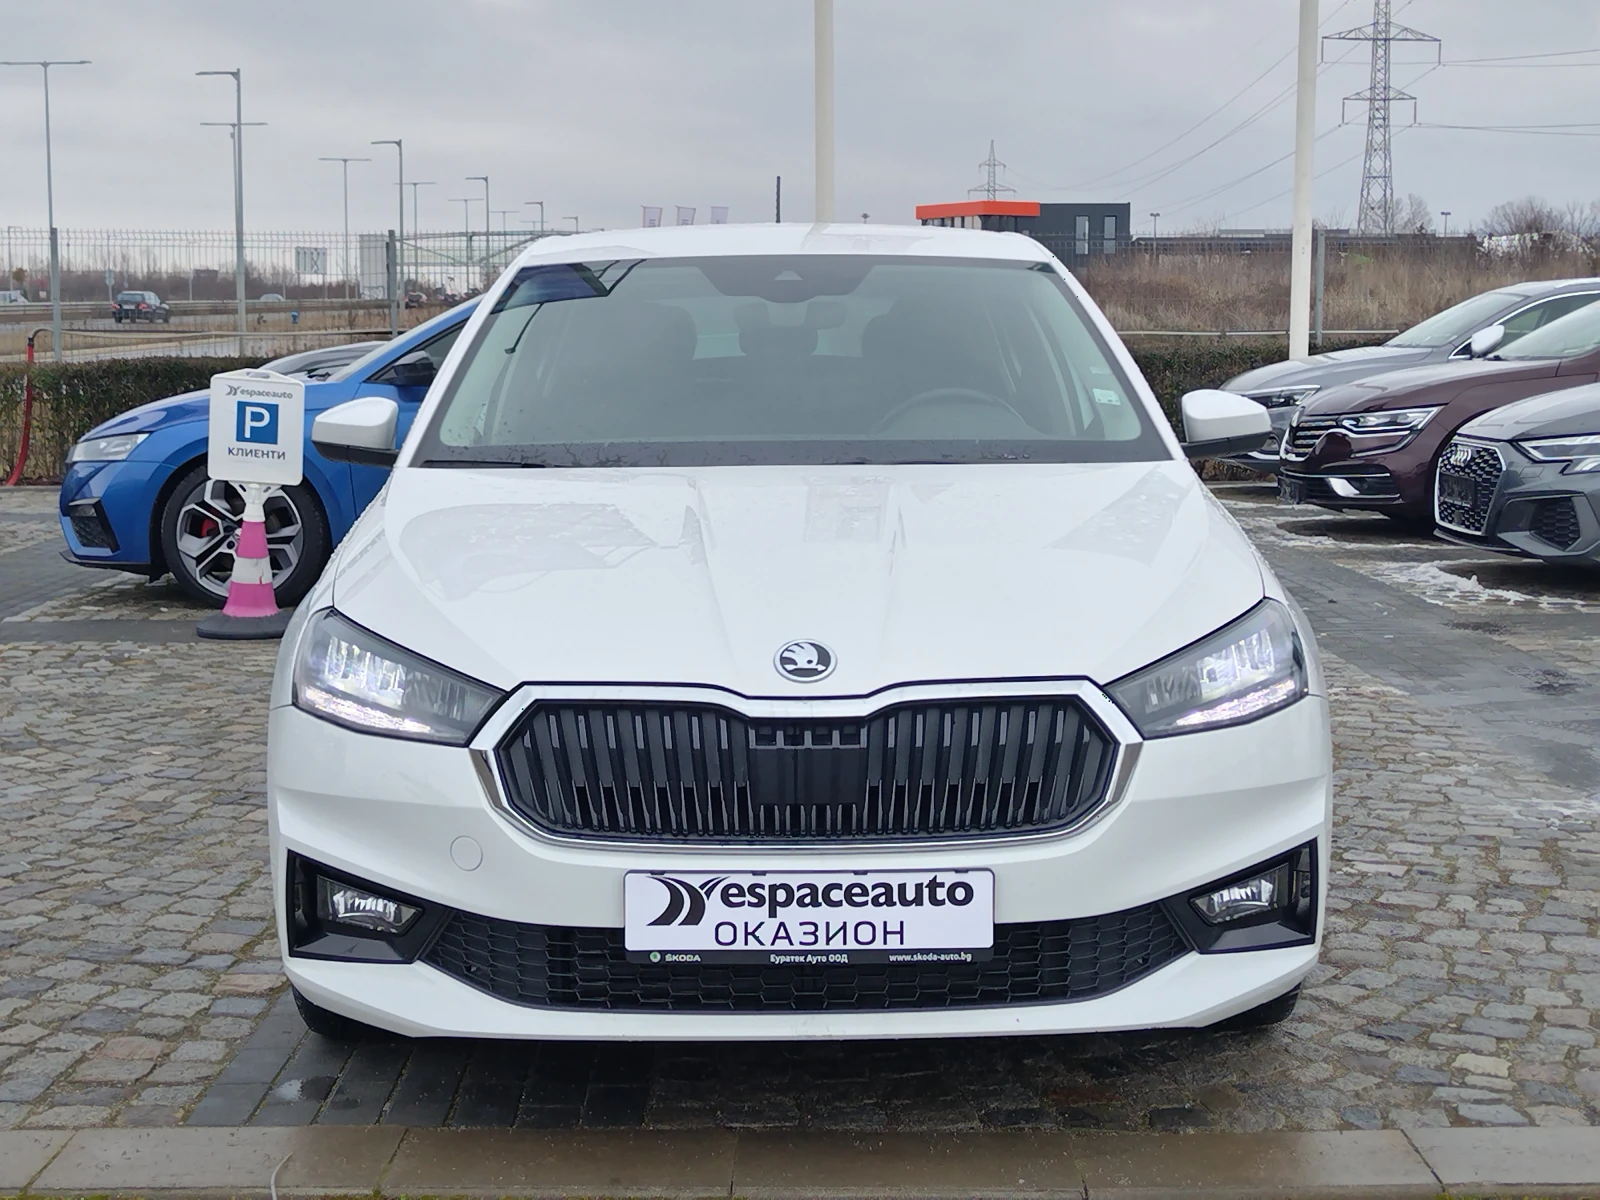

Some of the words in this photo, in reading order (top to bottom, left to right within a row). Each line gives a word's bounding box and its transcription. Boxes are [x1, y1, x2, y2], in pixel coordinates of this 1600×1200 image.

[240, 388, 294, 400] espaceauto
[244, 405, 271, 439] P
[227, 446, 286, 460] КЛИЕНТИ
[720, 875, 974, 919] espaceauto
[714, 920, 905, 946] ОКАЗИОН
[806, 954, 828, 965] Ауто
[888, 951, 972, 962] www.skoda-auto.bg
